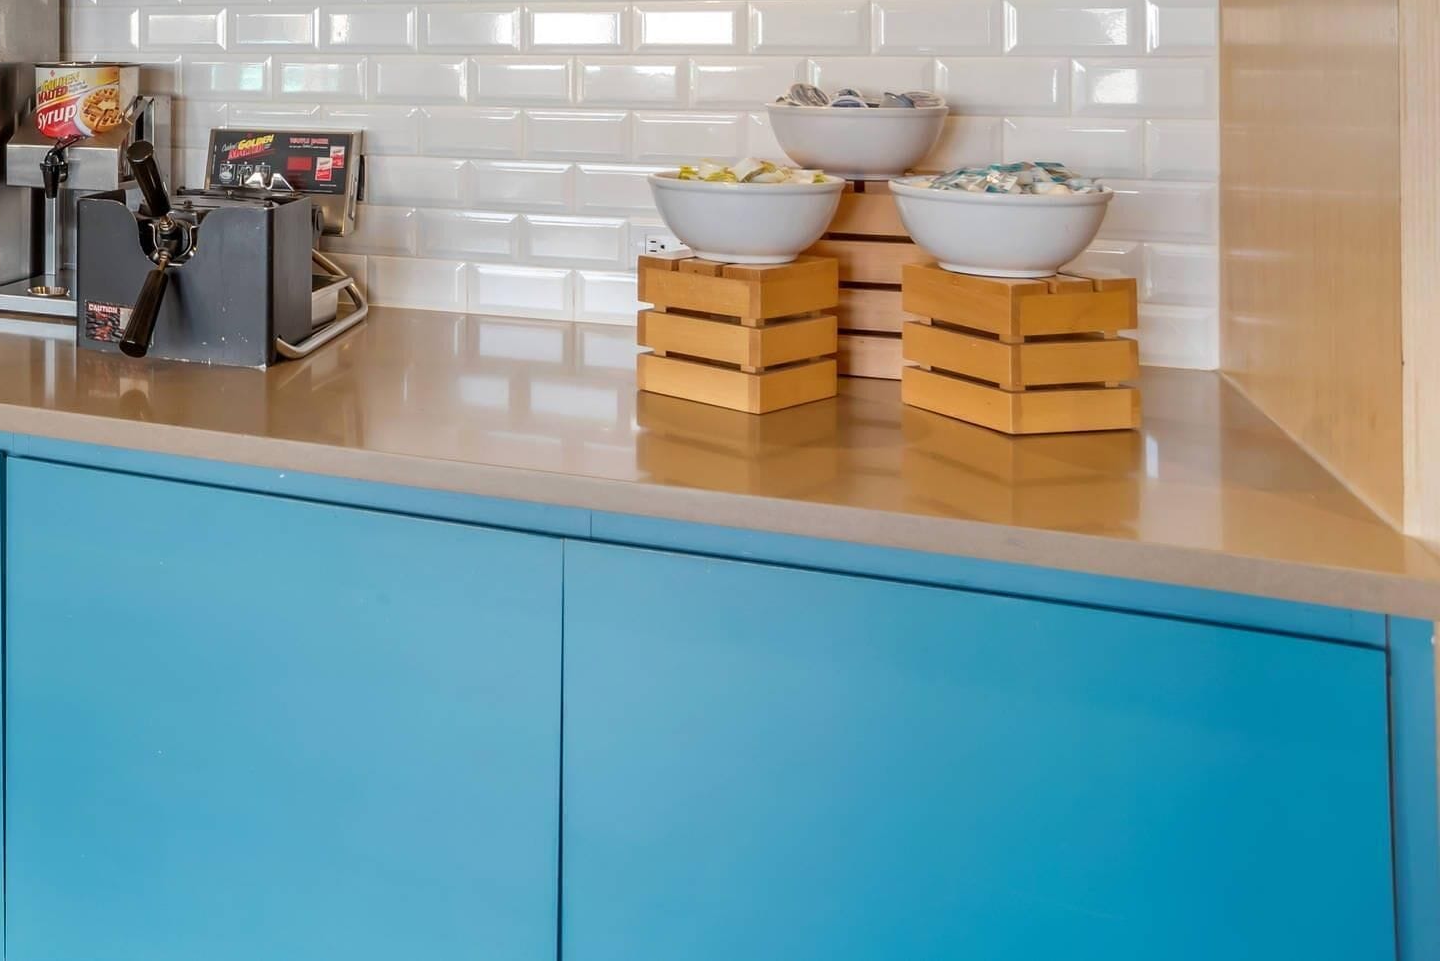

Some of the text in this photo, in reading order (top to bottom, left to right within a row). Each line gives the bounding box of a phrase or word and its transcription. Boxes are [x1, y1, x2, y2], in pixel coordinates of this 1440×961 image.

[37, 104, 77, 131] Syrup
[237, 133, 275, 151] GOLDEN
[88, 303, 119, 313] CAUTION
